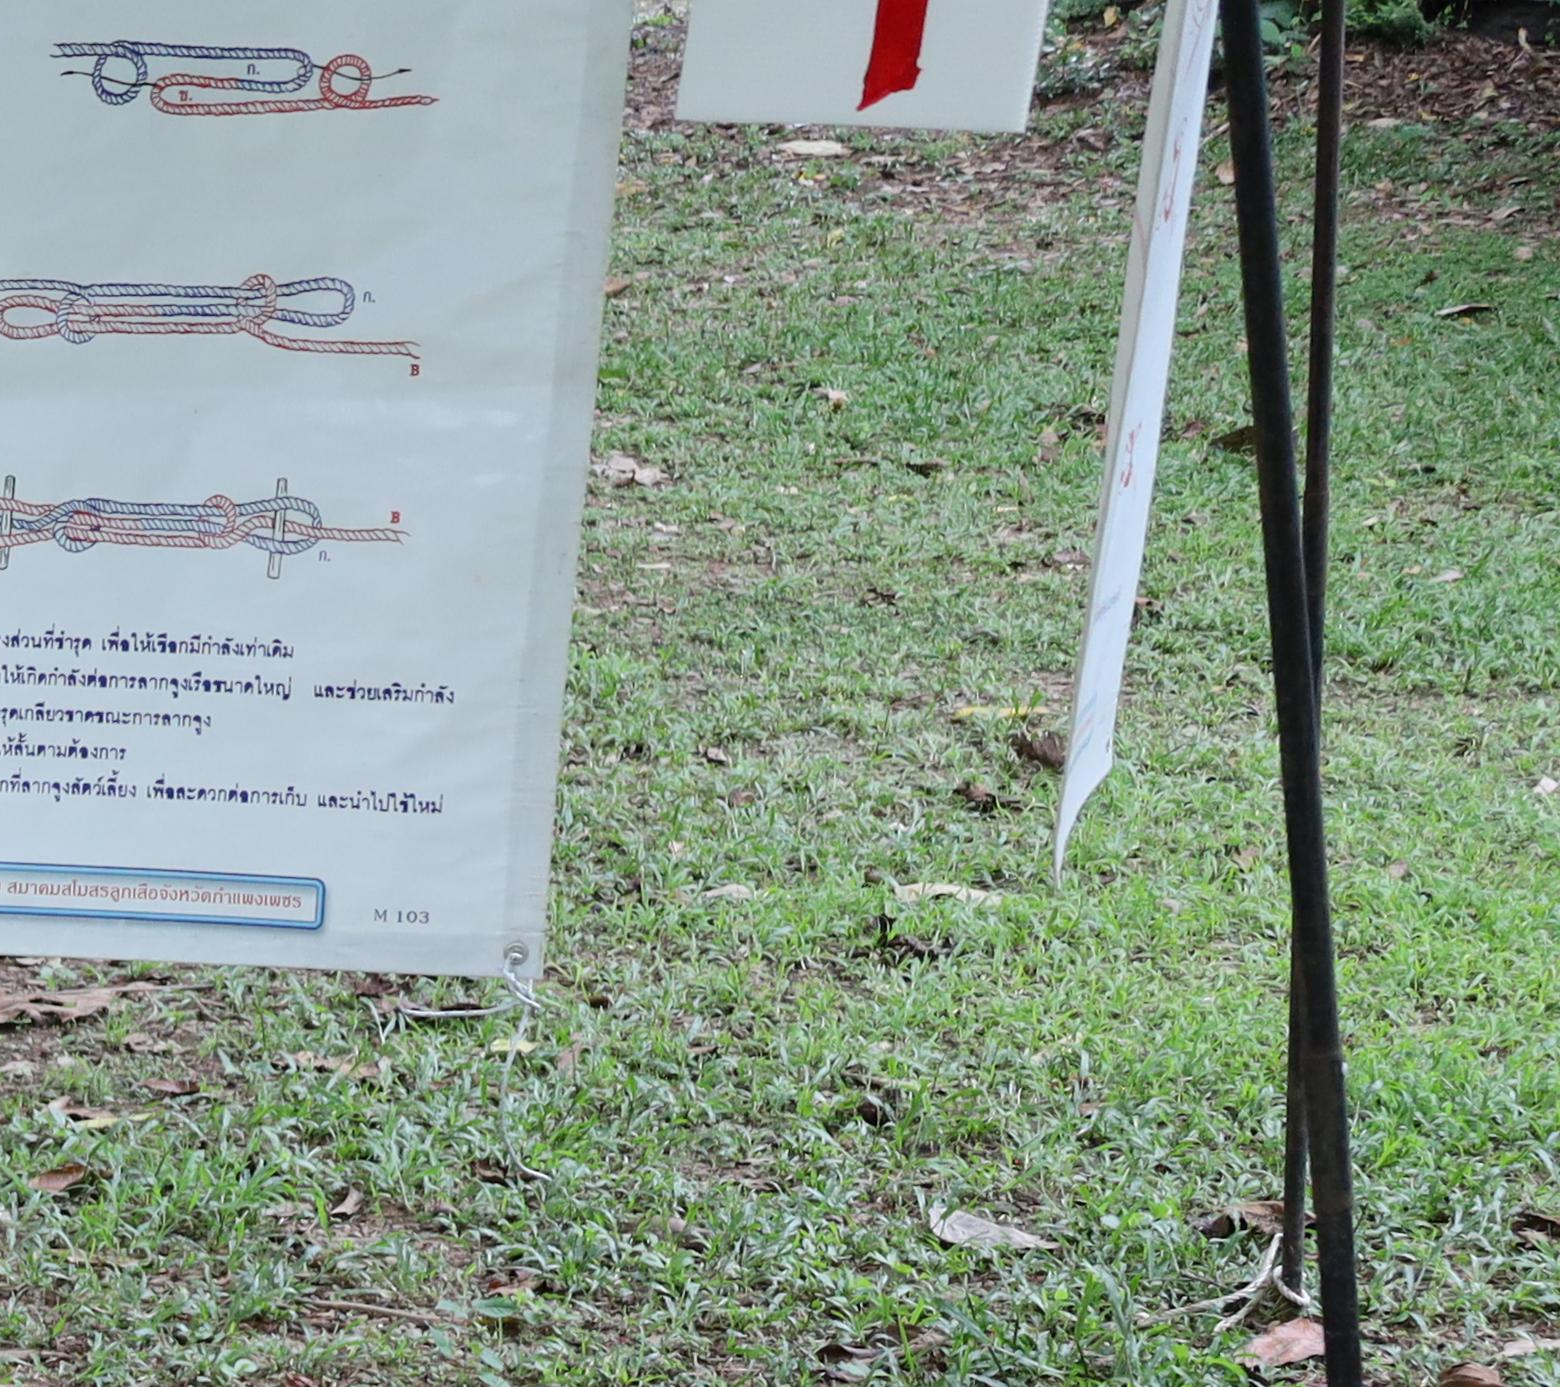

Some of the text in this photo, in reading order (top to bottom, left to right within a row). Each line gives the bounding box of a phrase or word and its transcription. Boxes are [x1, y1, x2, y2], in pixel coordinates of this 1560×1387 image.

[409, 363, 420, 376] B
[390, 511, 401, 524] B
[7, 877, 303, 910] สมาคมสโมสรลูกเสือจังหวัดกำแพงเพชร
[374, 909, 429, 924] M 103
